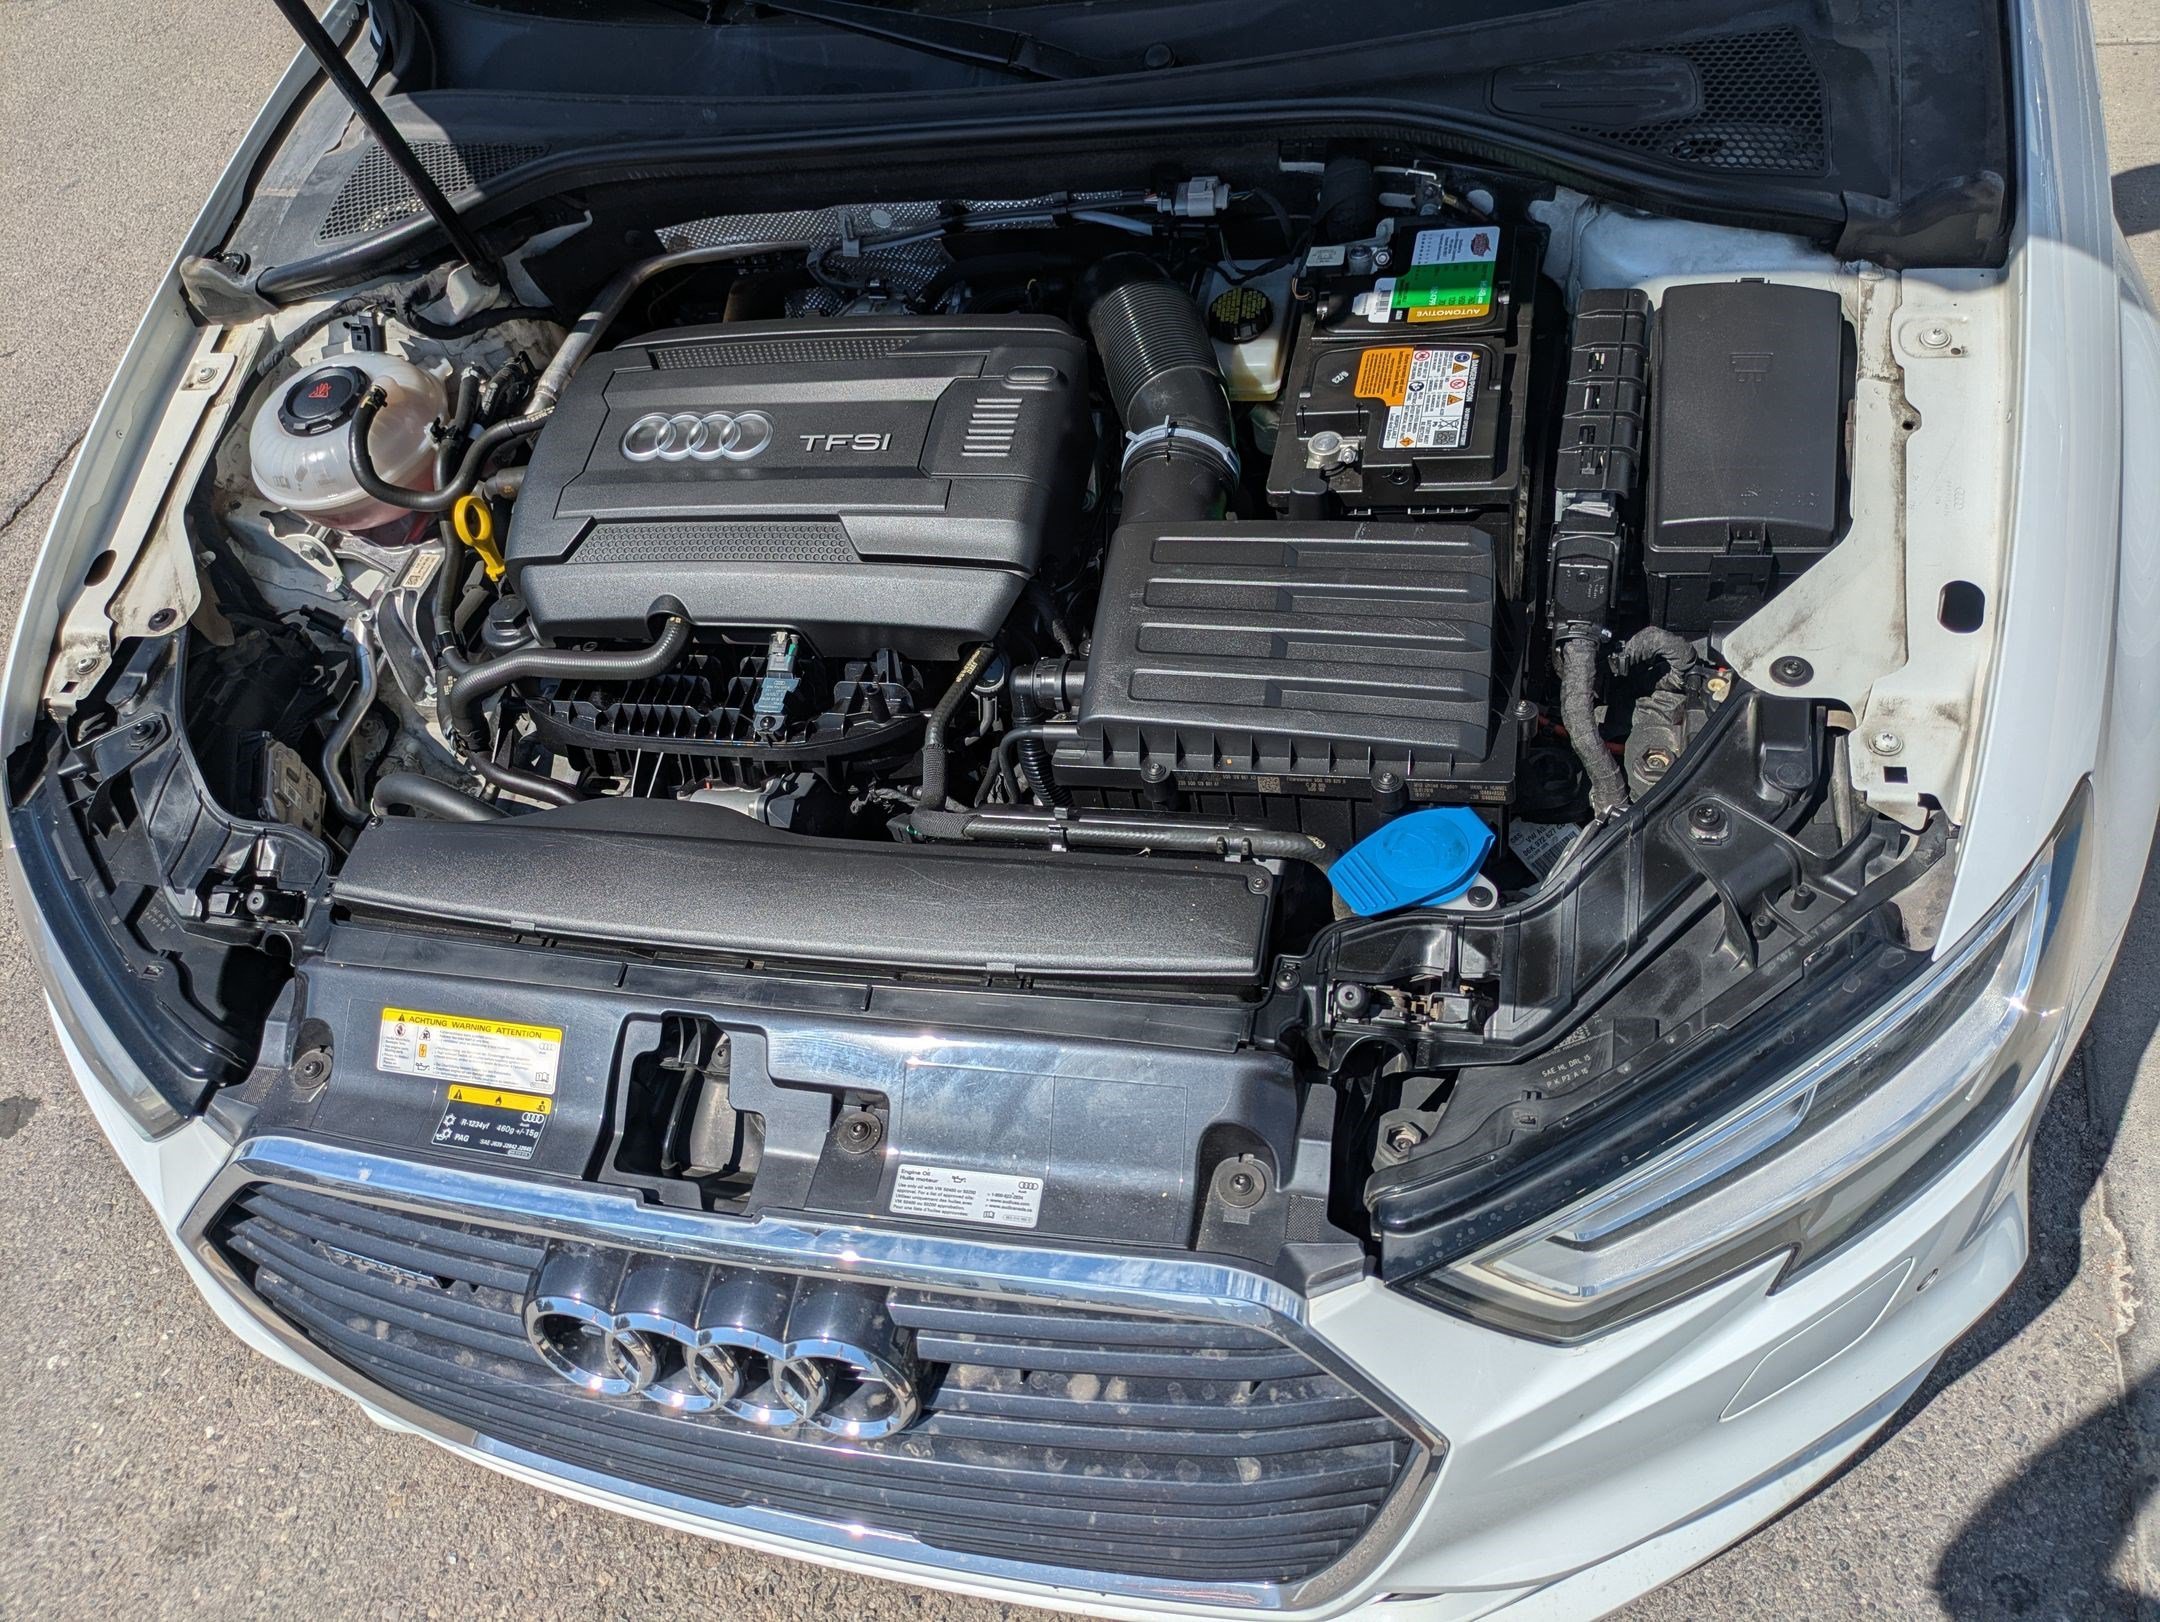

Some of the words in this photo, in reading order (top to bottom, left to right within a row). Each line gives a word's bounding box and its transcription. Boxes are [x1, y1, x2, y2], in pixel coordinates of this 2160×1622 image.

[1416, 308, 1481, 318] AUTOMOTIVE
[1466, 360, 1479, 402] DANGER/POISON
[800, 433, 892, 452] TFSI
[1526, 834, 1536, 843] VW
[409, 1016, 448, 1027] ACHTUNG
[451, 1021, 492, 1033] WARNING
[496, 1027, 541, 1039] ATTENTION
[1542, 1067, 1555, 1077] SAE
[460, 1119, 490, 1130] R-1234yf
[495, 1124, 515, 1135] 460g
[454, 1134, 470, 1142] PAG
